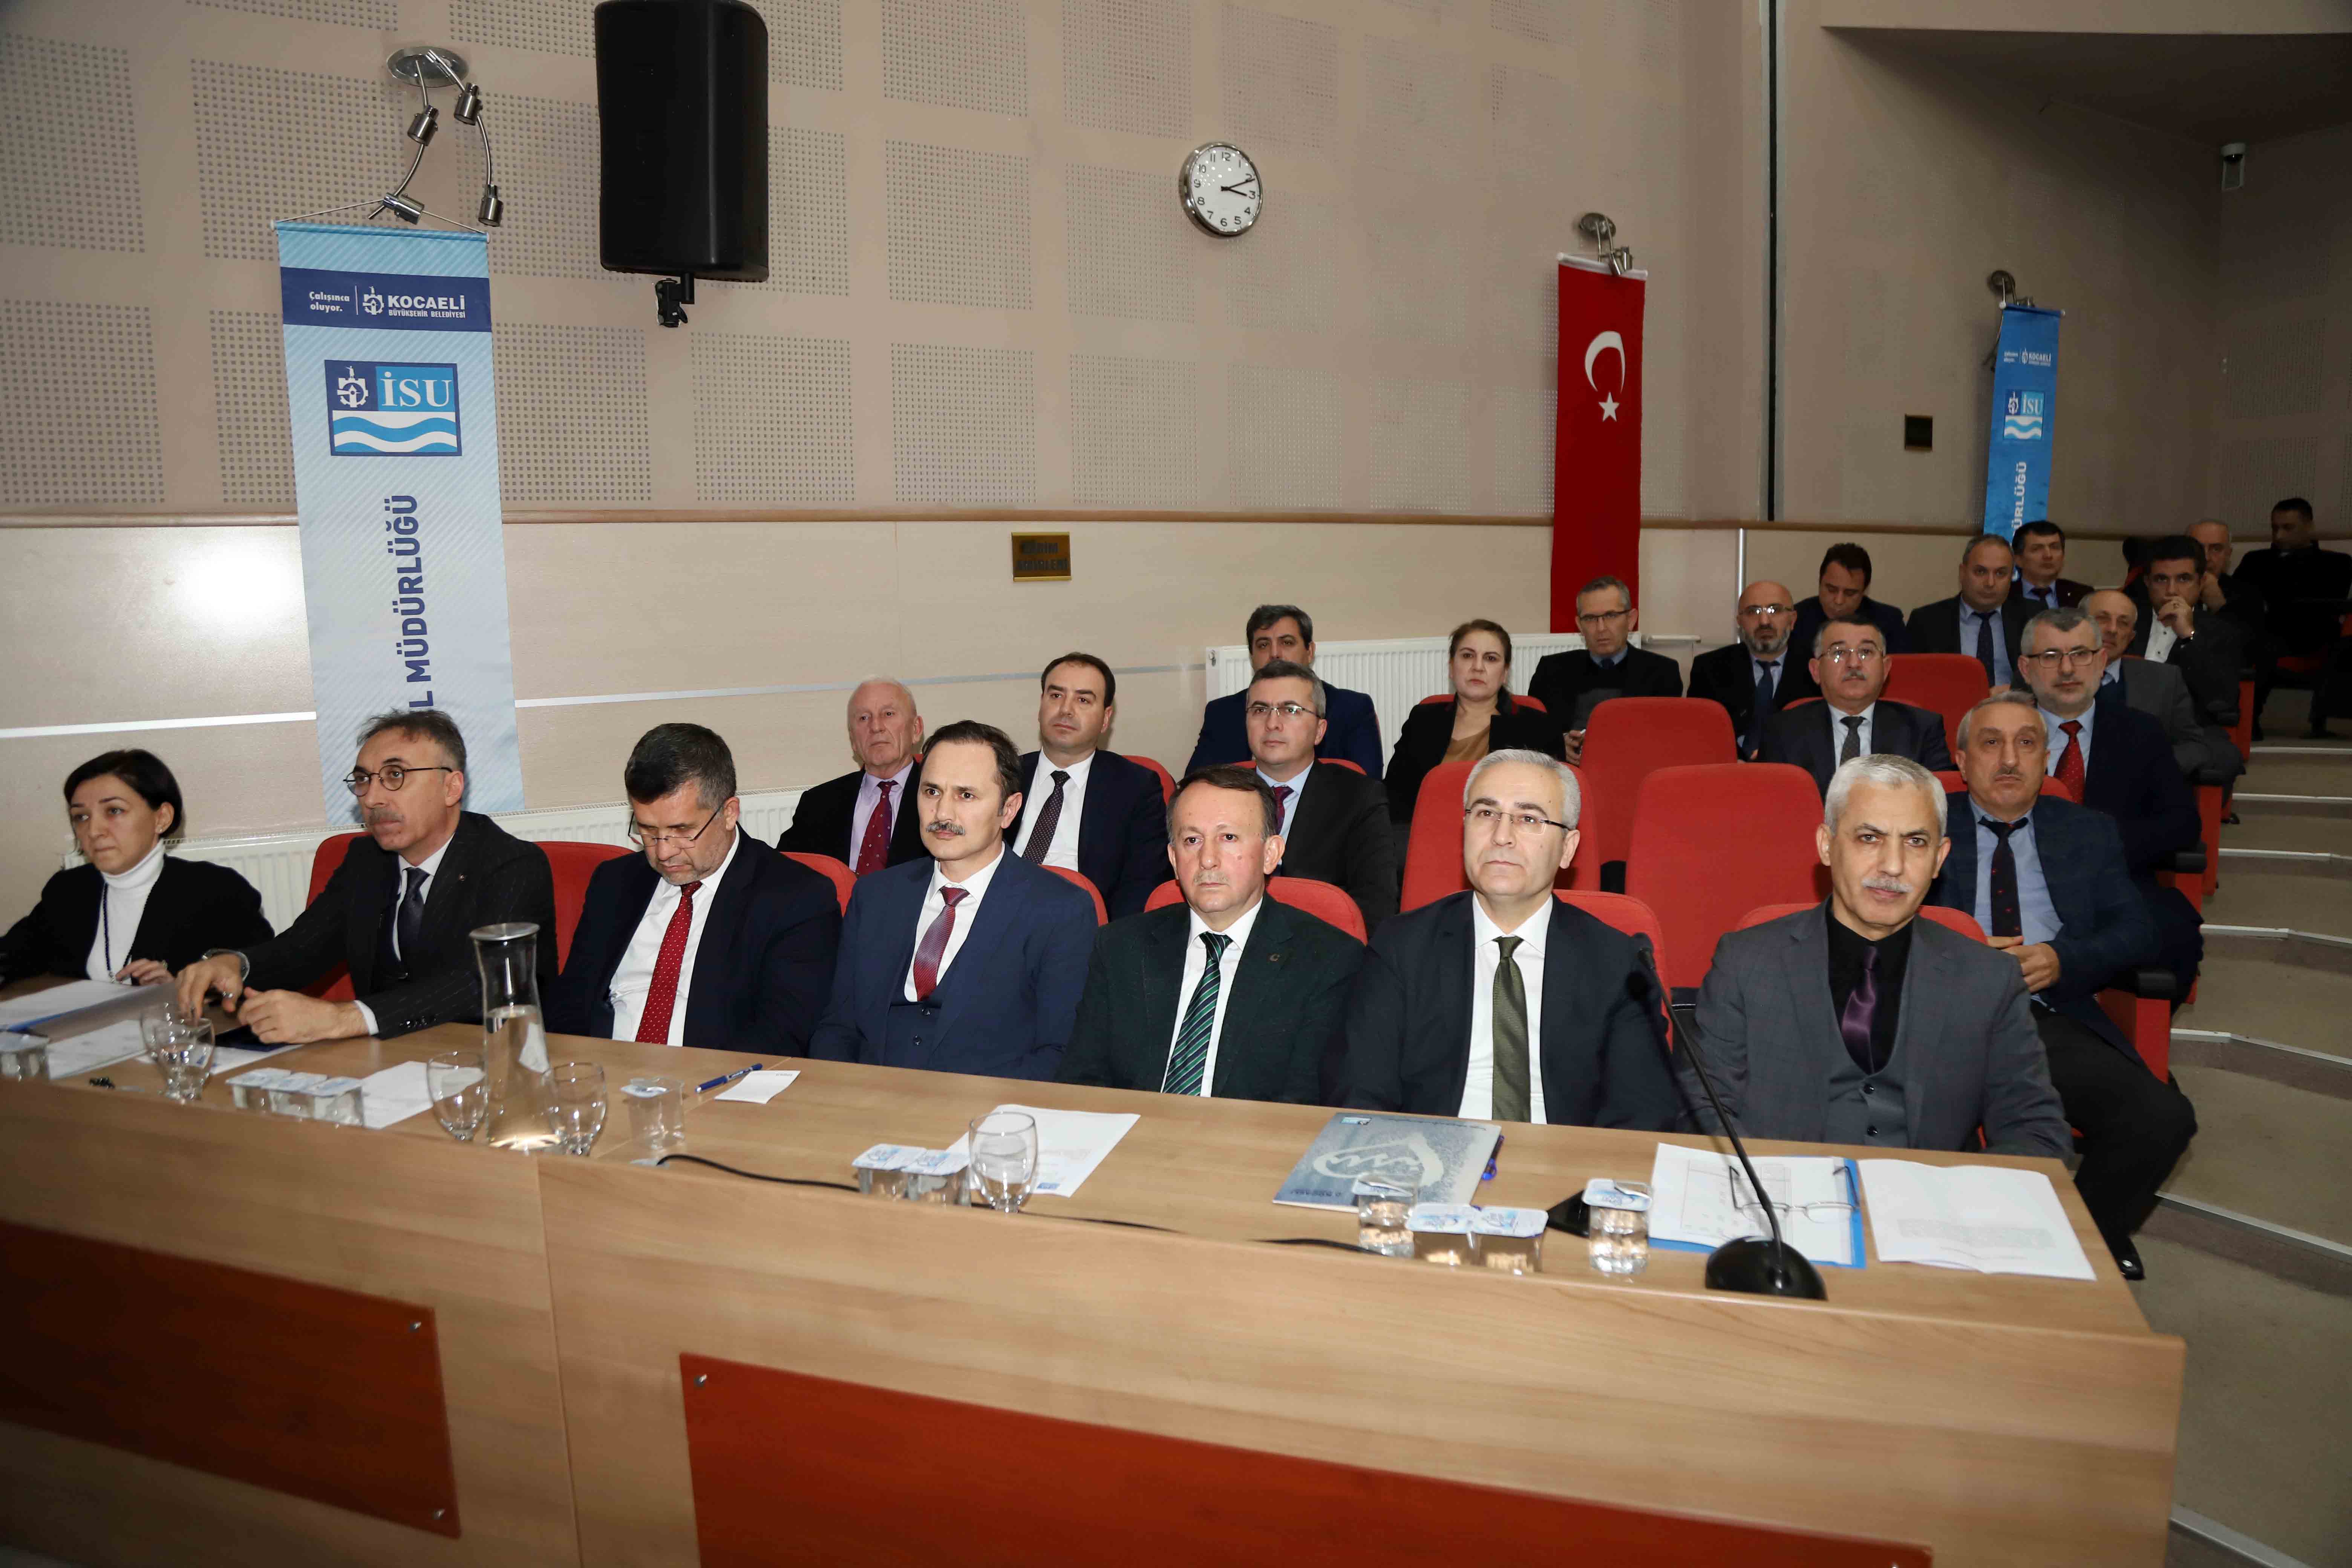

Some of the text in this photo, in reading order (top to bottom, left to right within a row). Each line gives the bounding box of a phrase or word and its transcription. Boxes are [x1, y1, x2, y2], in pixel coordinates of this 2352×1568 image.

[1210, 153, 1216, 162] 11
[1222, 152, 1231, 162] 12
[1199, 164, 1207, 173] 10
[1245, 173, 1253, 182] 2
[1194, 178, 1201, 188] 9
[1248, 190, 1256, 199] 3
[1197, 197, 1205, 205] 8
[1207, 210, 1213, 219] 7
[1244, 207, 1251, 215] 4
[1220, 218, 1228, 227] 6
[1234, 216, 1242, 225] 5
[309, 291, 350, 302] Çalışınca
[388, 295, 465, 310] KOCAELİ
[310, 302, 343, 313] oluyor.
[380, 371, 452, 407] İSU
[2011, 461, 2027, 537] ÜRLÜĞÜ
[384, 495, 432, 682] MÜDÜRLÜĞÜ
